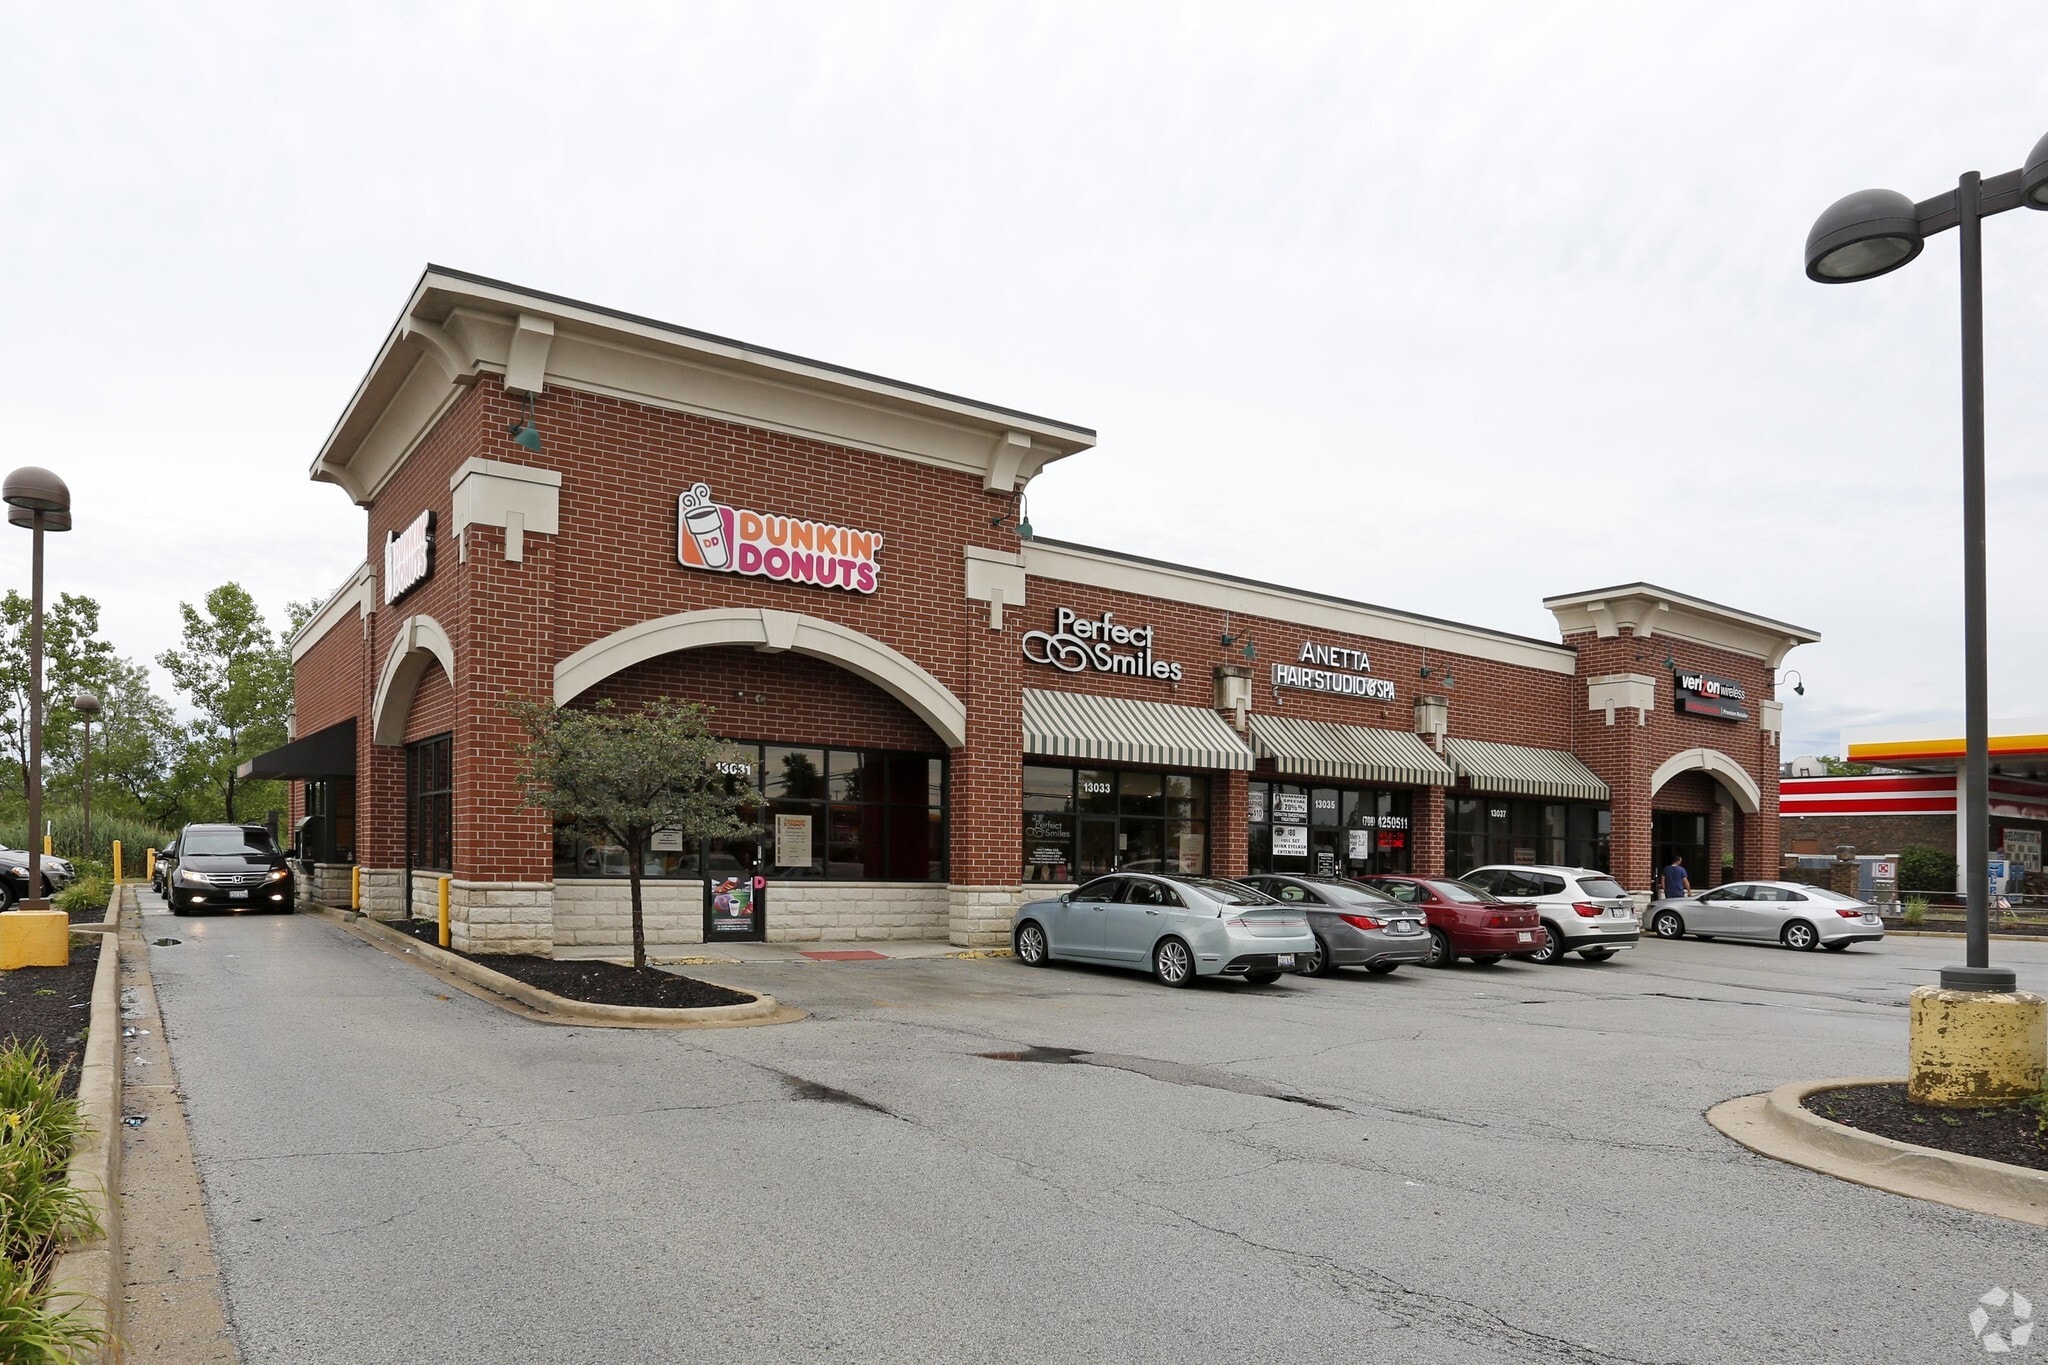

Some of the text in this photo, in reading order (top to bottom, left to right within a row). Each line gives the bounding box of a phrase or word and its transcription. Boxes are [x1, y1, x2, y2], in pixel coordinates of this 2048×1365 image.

[703, 536, 719, 548] DD
[739, 512, 882, 561] DUNKIN'
[738, 542, 875, 591] DONUTS
[1057, 607, 1154, 647] Perfect
[1094, 642, 1183, 681] Smiles
[1301, 641, 1371, 672] ANETTA
[1277, 664, 1396, 700] HAIR STUDIO & SPA
[1682, 674, 1746, 700] verizon wireless
[715, 762, 751, 776] 13031
[1083, 782, 1111, 794] 13033
[1314, 799, 1336, 810] 13035
[1491, 809, 1507, 818] 13037
[1035, 820, 1062, 830] Perfect
[1377, 815, 1408, 829] 4250511
[1045, 828, 1071, 838] Smiles
[753, 875, 766, 889] D
